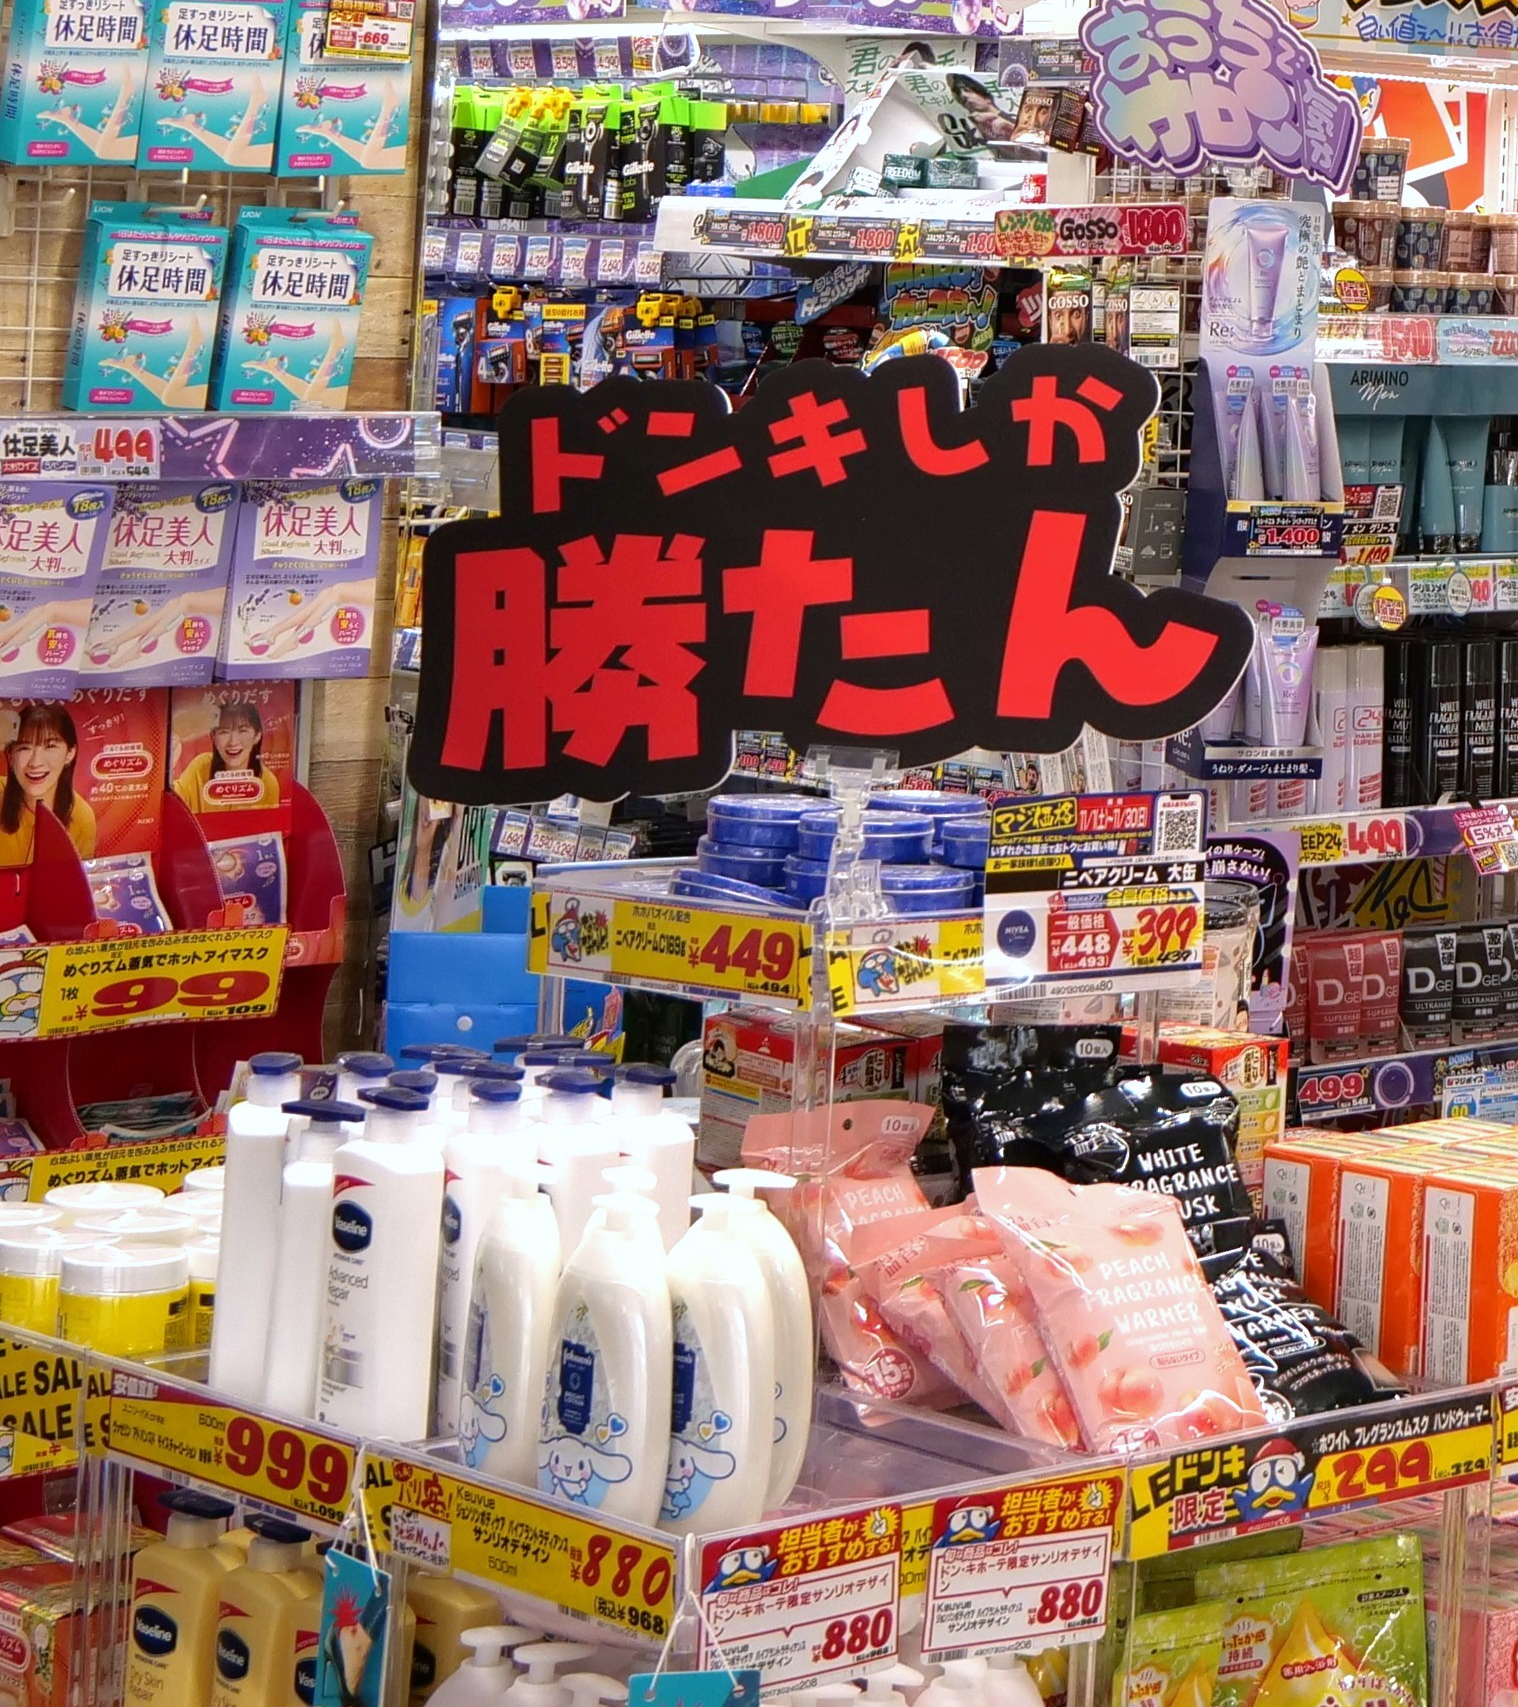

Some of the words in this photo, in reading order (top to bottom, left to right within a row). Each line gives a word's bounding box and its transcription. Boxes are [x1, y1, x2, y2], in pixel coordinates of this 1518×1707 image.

[54, 13, 138, 44] 休足時間
[178, 8, 254, 23] 足すっきりシート
[173, 24, 269, 55] 休足時間
[121, 249, 195, 266] 足すっきりシート
[116, 264, 206, 296] 休足時間
[1351, 370, 1409, 389] ARIMINO
[532, 372, 1126, 515] ドンキしか
[113, 504, 215, 550] 休足美人
[263, 505, 363, 540] 休足美人
[440, 508, 1221, 772] 勝たん
[1063, 866, 1158, 885] ニベアクリーム
[1168, 863, 1197, 881] 大缶
[1138, 1142, 1205, 1172] WHITE
[1100, 1251, 1171, 1279] PEACH
[1114, 1298, 1204, 1335] WARMER
[135, 1617, 172, 1644] Vaseline
